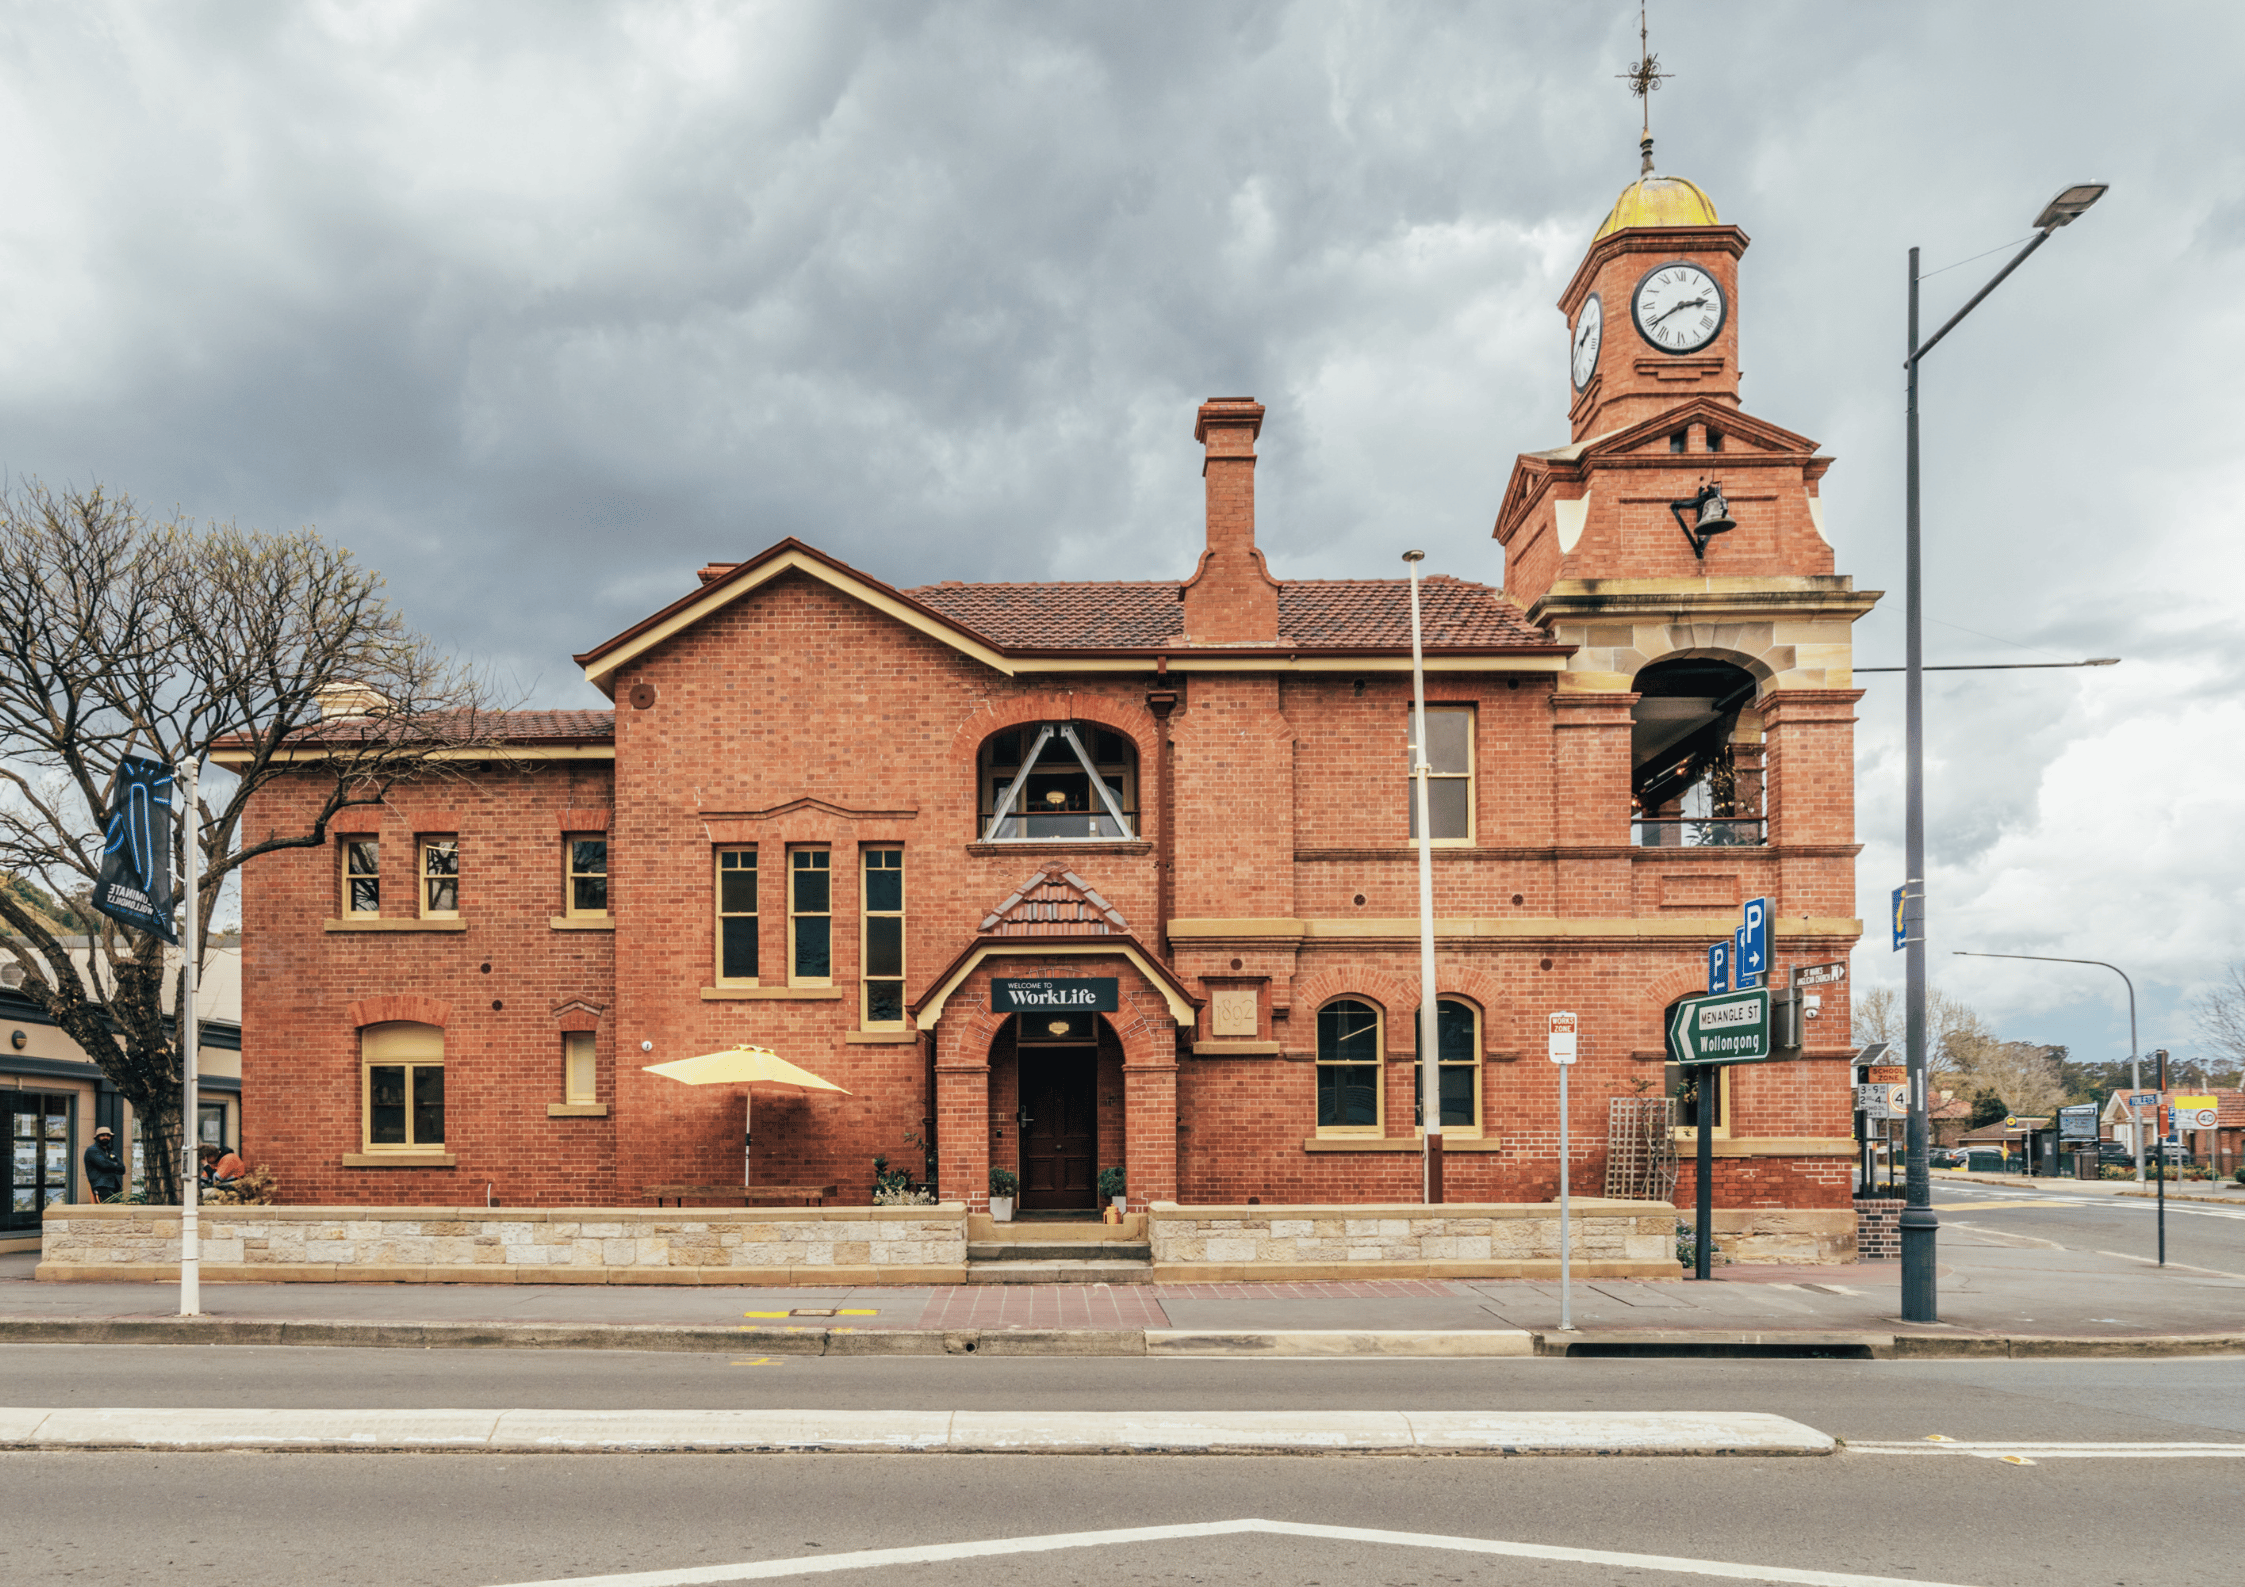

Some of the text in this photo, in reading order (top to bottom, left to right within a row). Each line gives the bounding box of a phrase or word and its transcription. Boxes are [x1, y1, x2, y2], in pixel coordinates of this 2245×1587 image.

[1747, 904, 1762, 943] P
[1714, 948, 1724, 977] P
[1008, 988, 1096, 1005] WorkLife
[1216, 998, 1254, 1028] 1892
[1552, 1017, 1574, 1025] WORKS
[1701, 1005, 1758, 1025] MENANGLE ST
[1554, 1025, 1572, 1033] ZONE
[1700, 1034, 1759, 1055] Wollongong
[1894, 1093, 1905, 1104] 4
[2200, 1114, 2215, 1123] 40
